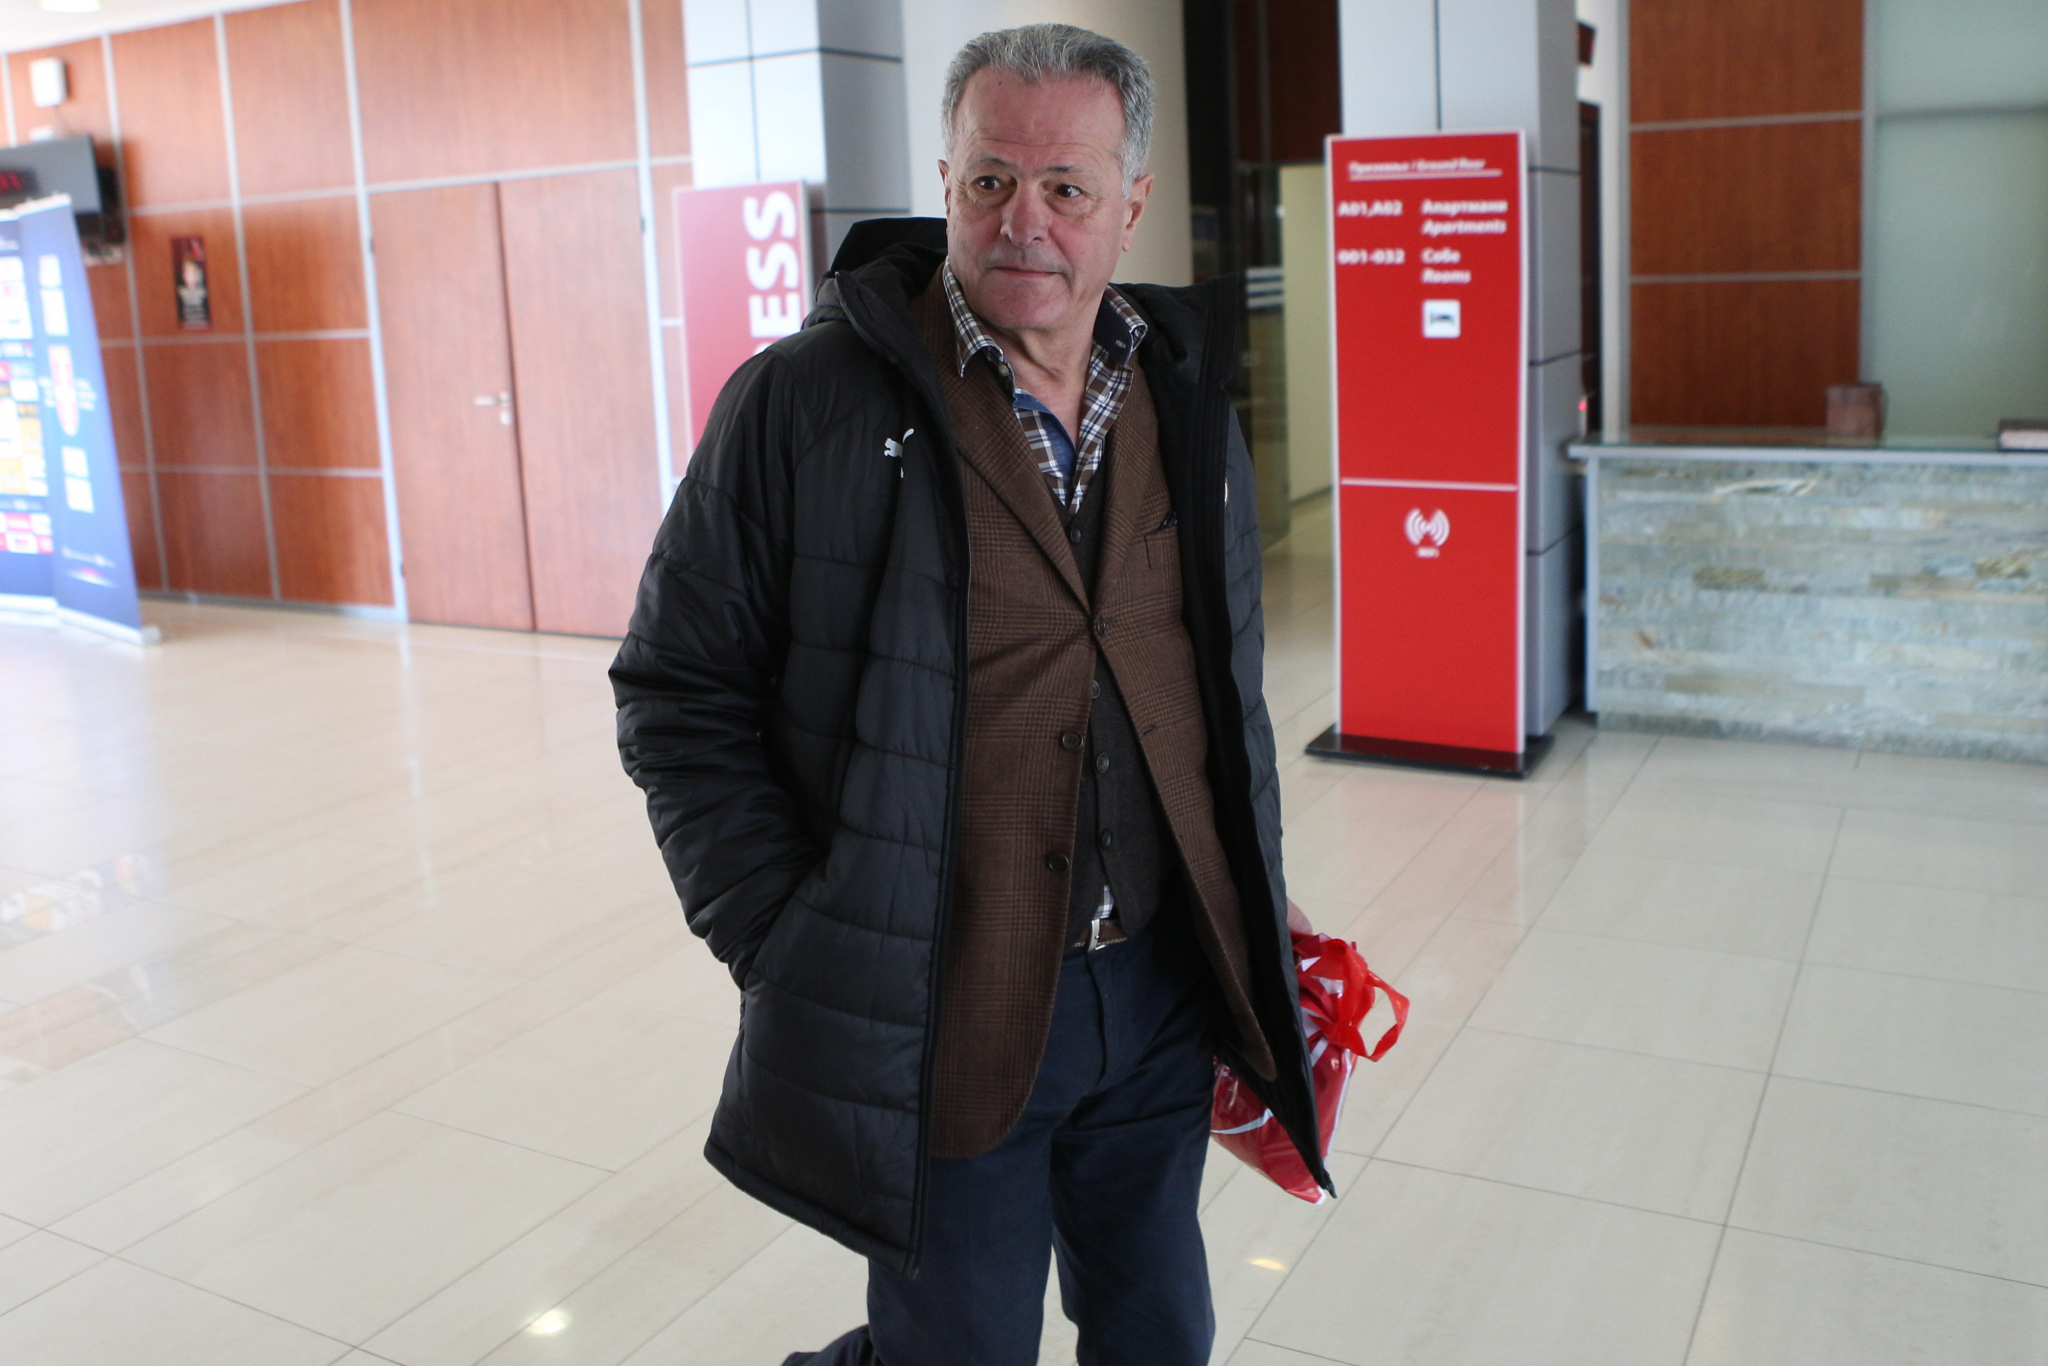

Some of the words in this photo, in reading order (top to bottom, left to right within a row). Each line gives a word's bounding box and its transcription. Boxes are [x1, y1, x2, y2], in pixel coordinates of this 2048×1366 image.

[1421, 199, 1508, 217] Апартмани
[1421, 219, 1507, 237] Apartments
[1421, 247, 1461, 264] Собе
[743, 190, 801, 355] ESS
[1421, 268, 1471, 284] Rooms
